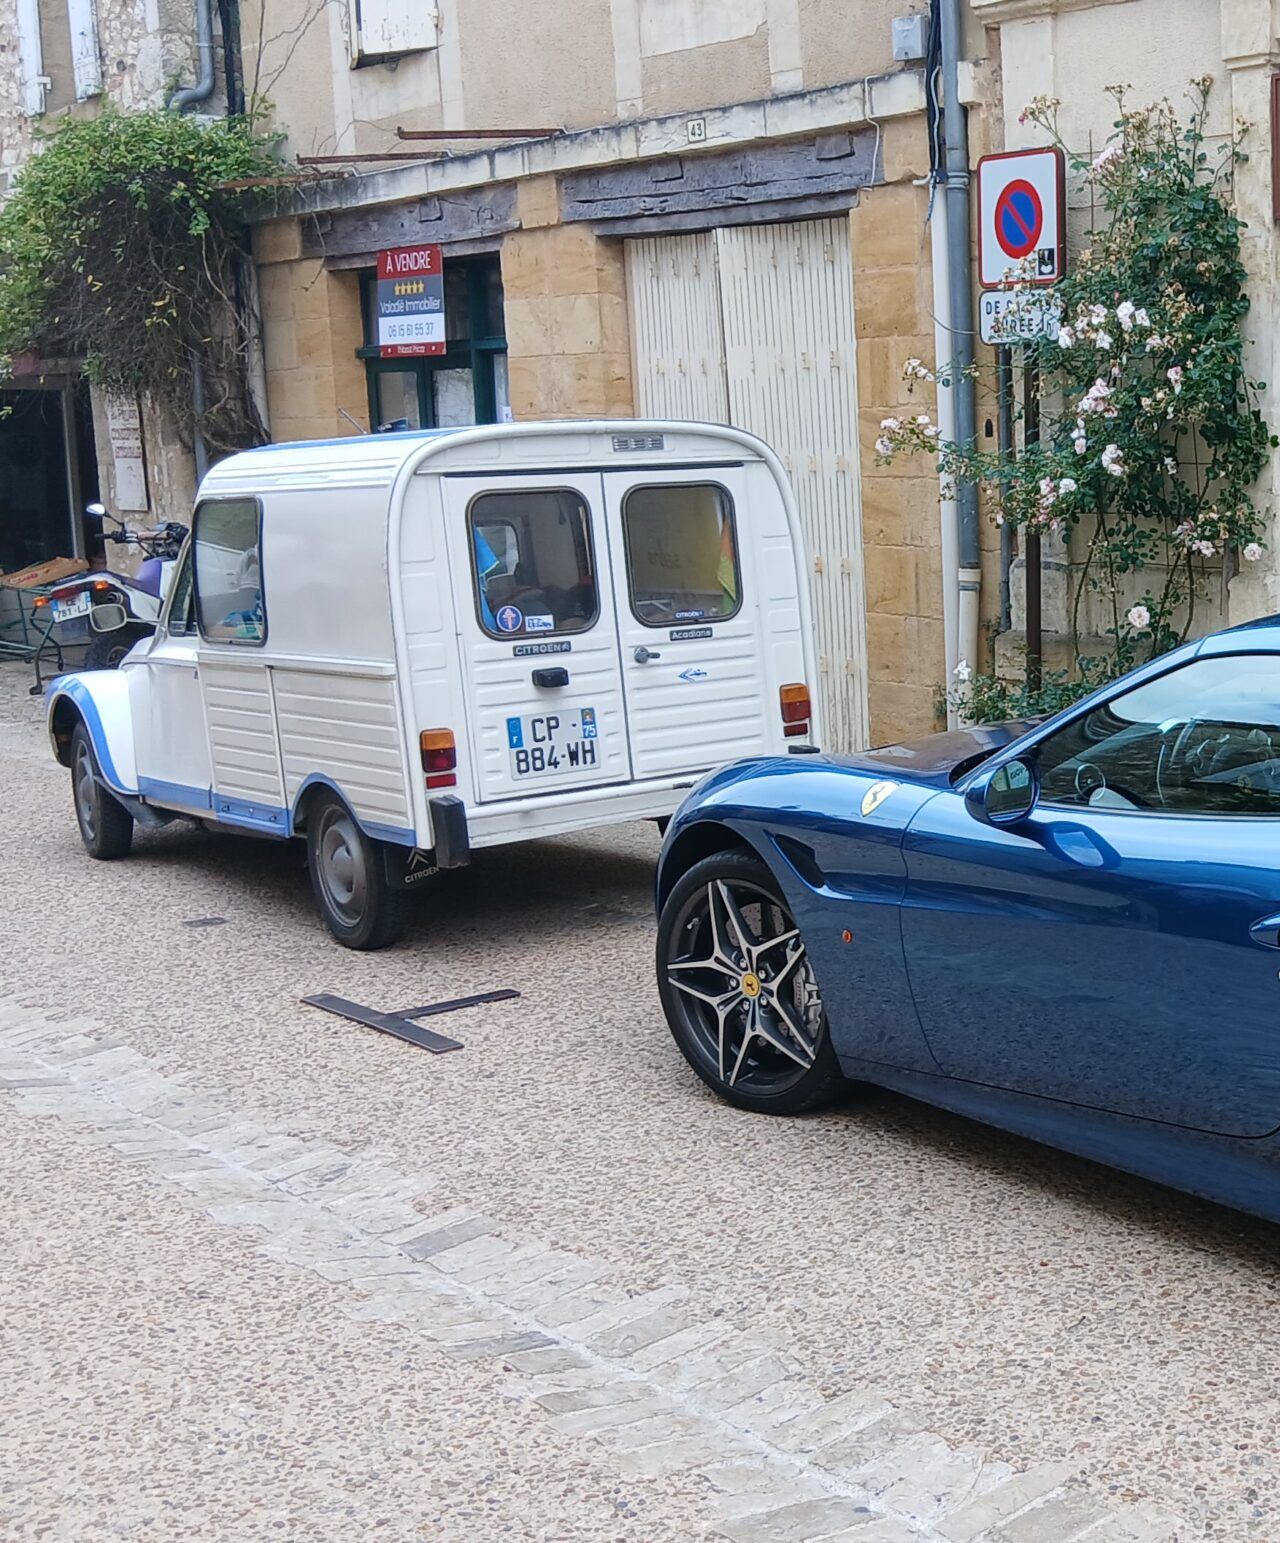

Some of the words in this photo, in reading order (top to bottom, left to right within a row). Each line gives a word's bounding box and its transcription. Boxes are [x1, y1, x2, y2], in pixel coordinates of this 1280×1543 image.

[690, 123, 702, 137] 43
[386, 251, 393, 273] À
[395, 250, 431, 272] VENDRE
[986, 301, 1000, 315] DE
[583, 724, 596, 737] 75
[512, 736, 518, 744] F
[516, 740, 596, 775] 884-WH
